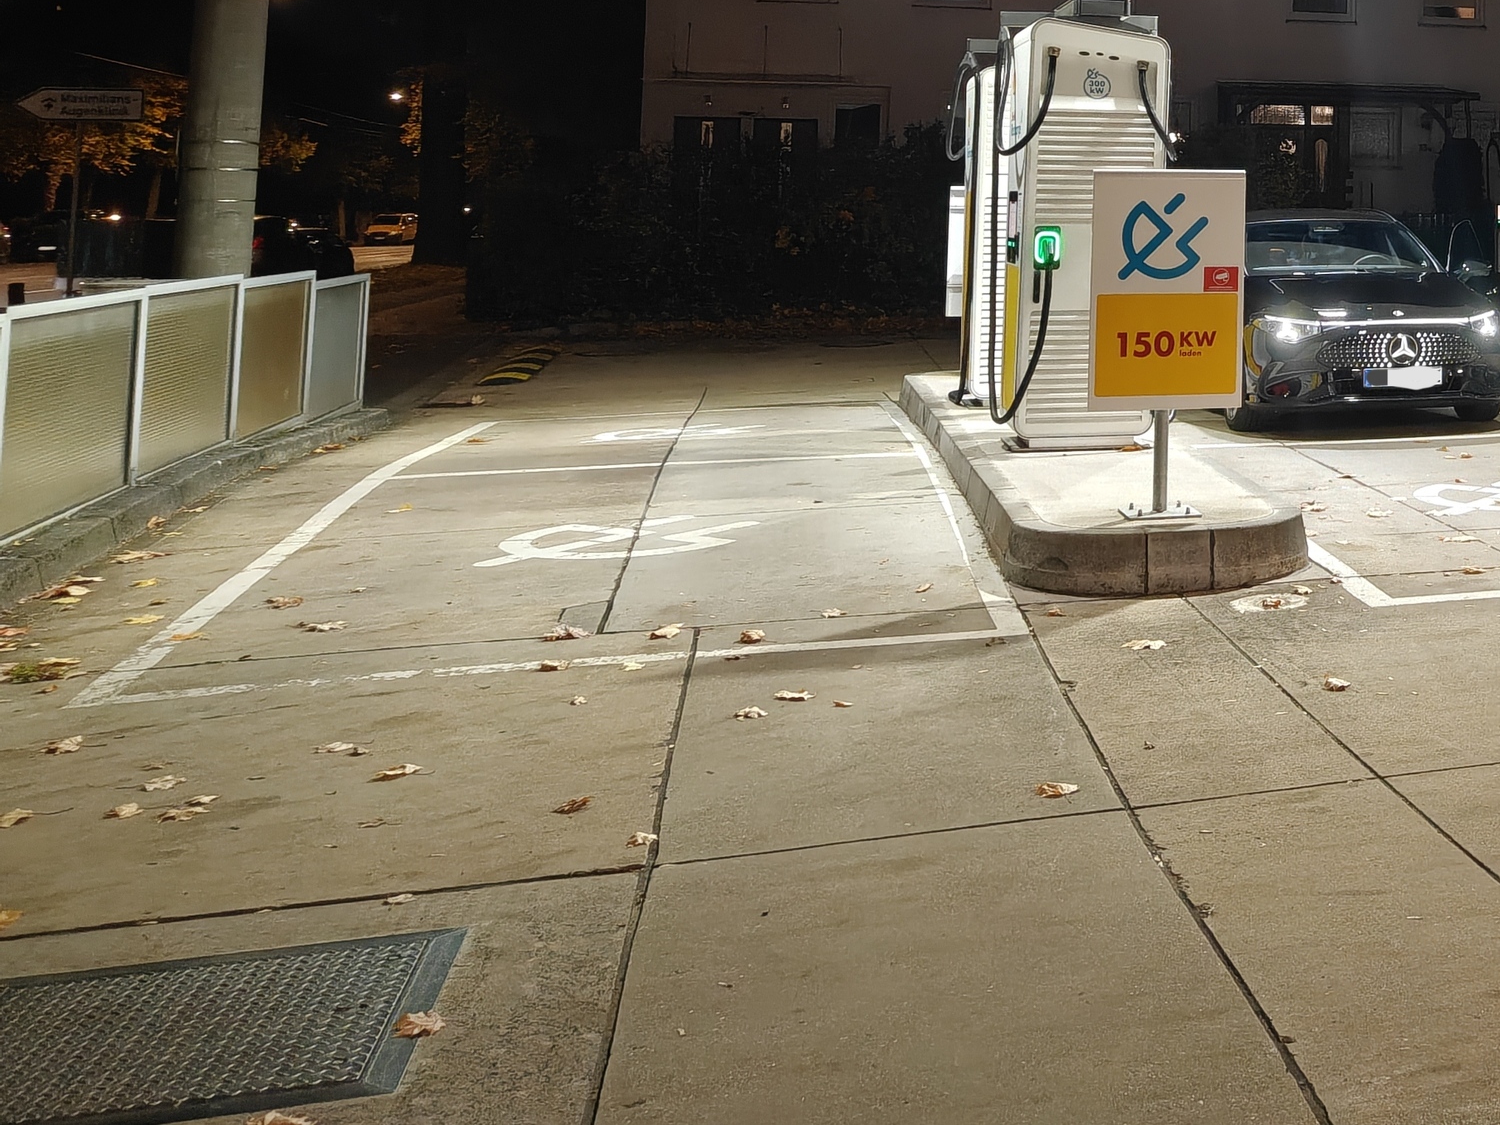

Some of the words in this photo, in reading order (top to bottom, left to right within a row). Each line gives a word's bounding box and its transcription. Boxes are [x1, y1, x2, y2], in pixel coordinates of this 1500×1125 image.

[1117, 331, 1175, 358] 150
[1179, 331, 1217, 348] KW
[1179, 349, 1202, 357] laden
